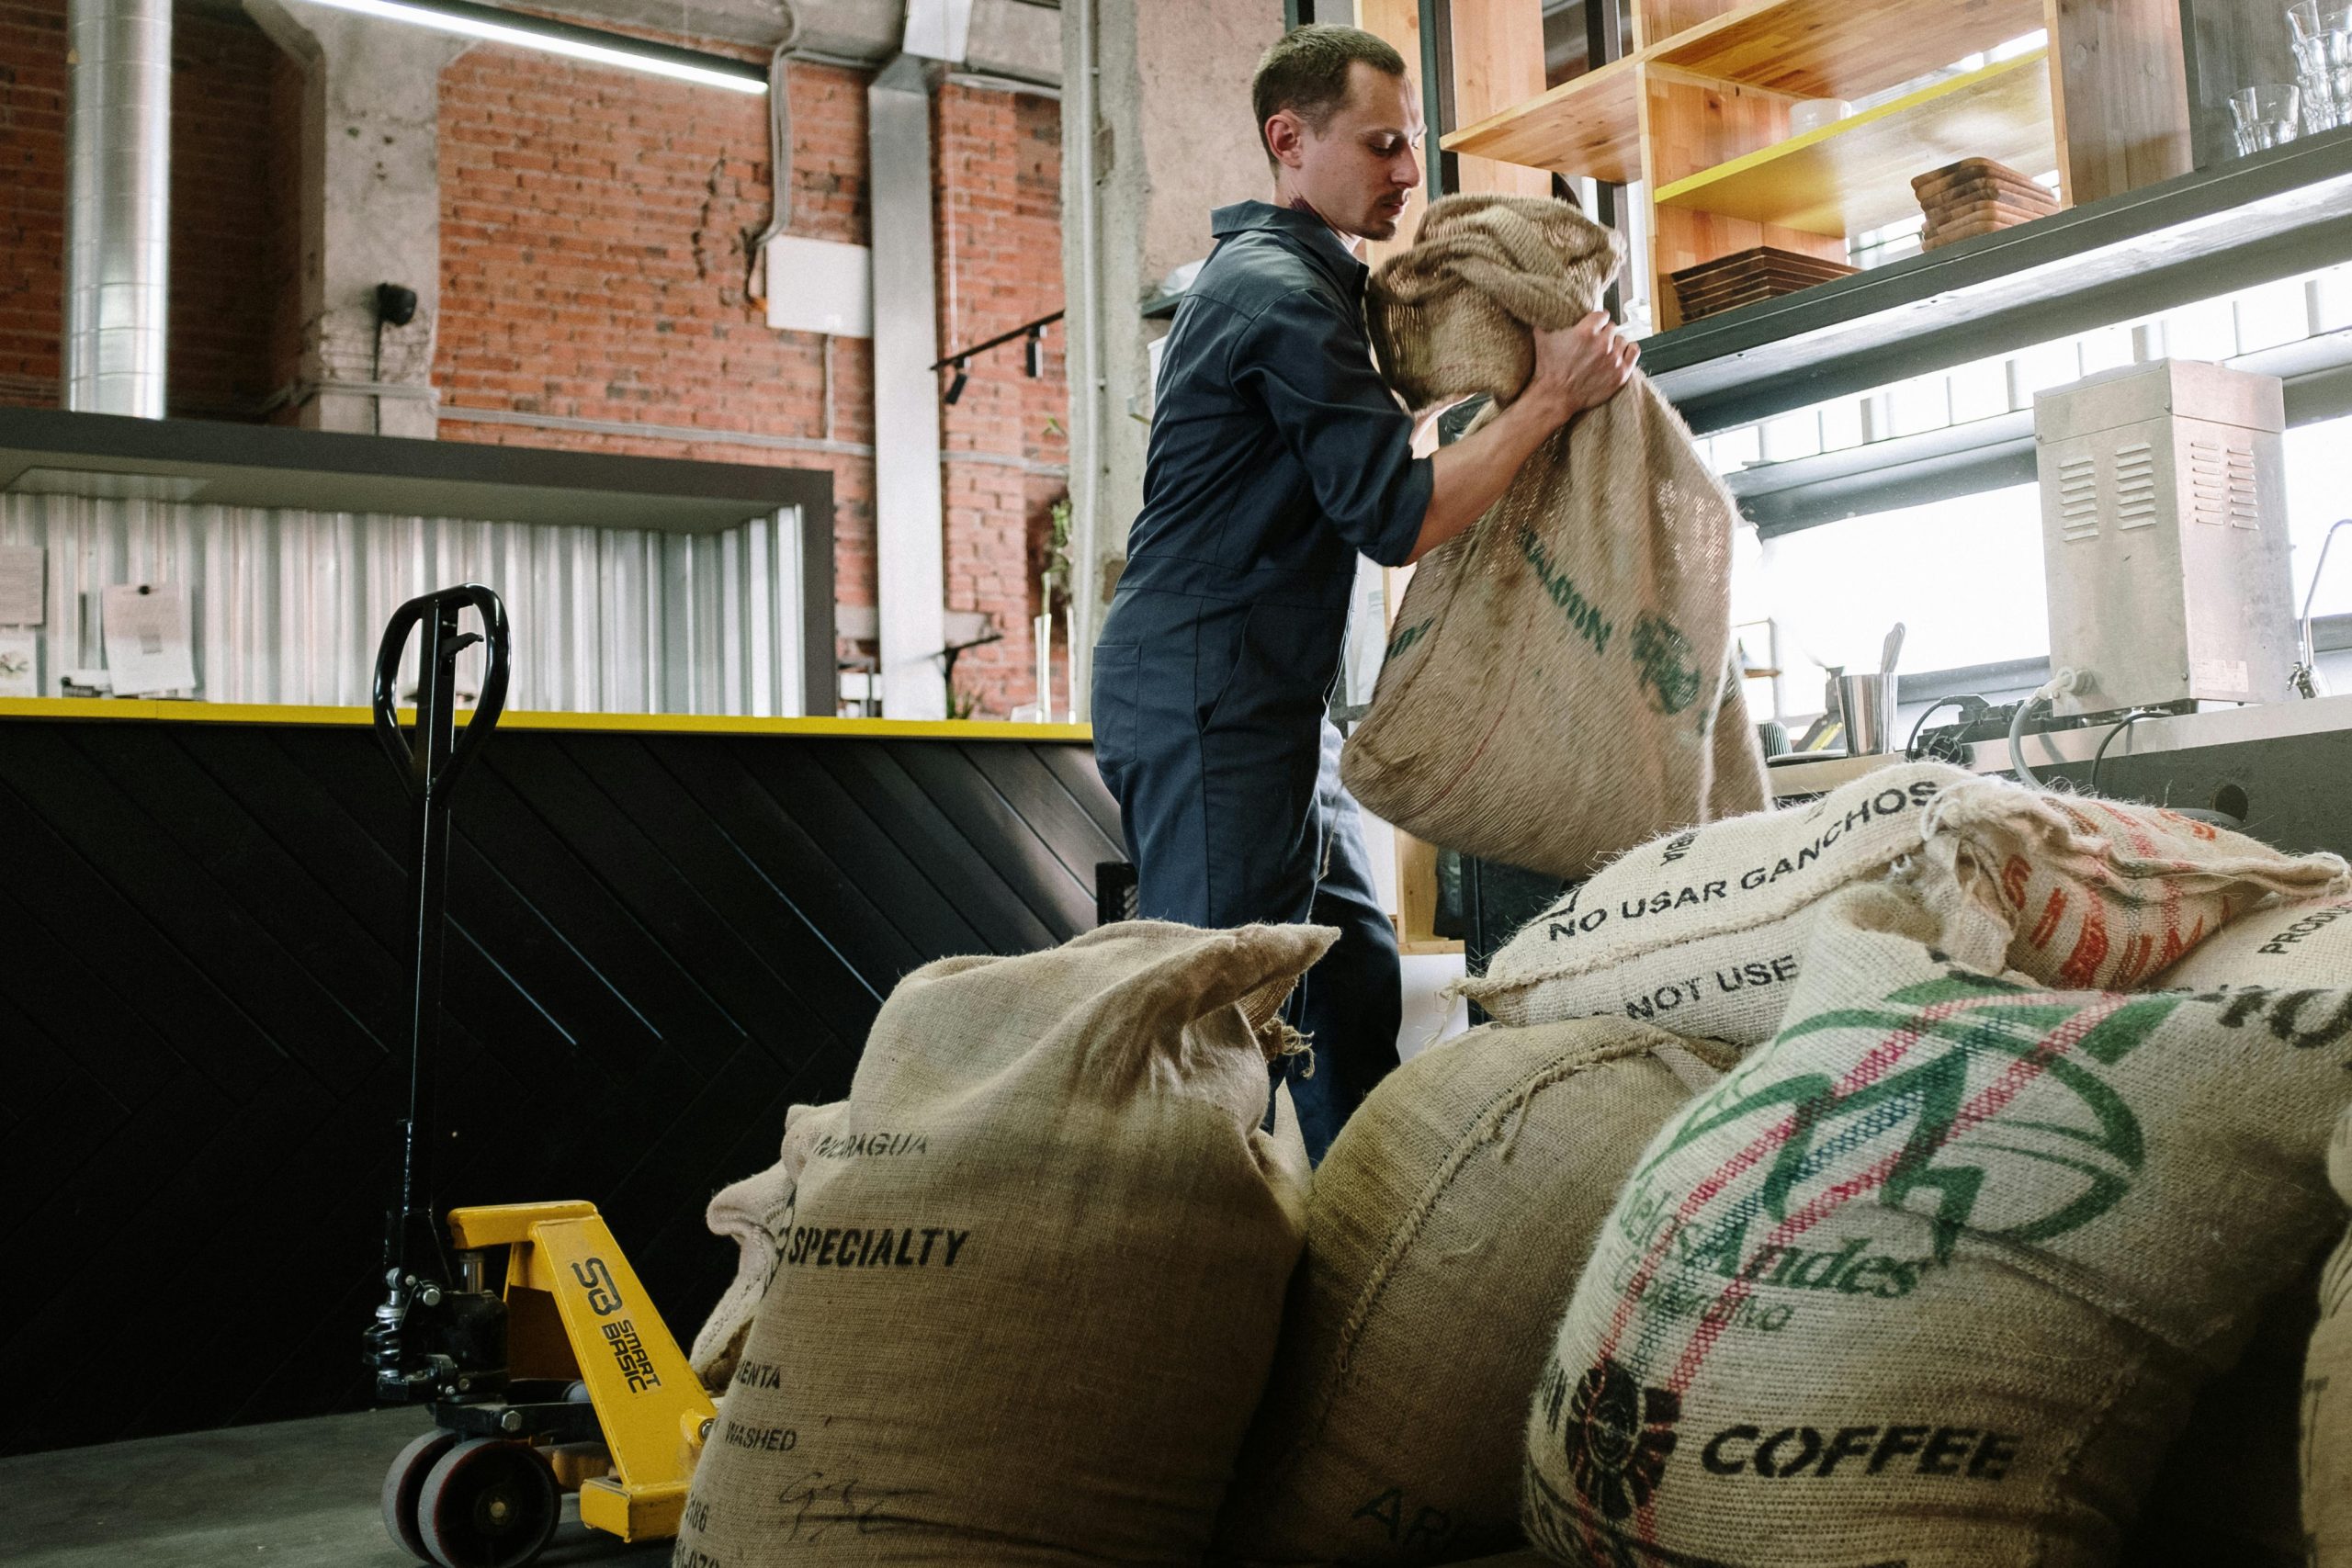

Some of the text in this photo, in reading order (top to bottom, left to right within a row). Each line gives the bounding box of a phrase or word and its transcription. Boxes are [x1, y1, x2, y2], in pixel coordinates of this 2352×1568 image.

[1549, 908, 1607, 942] NO
[1622, 880, 1727, 919] USAR
[1740, 780, 1939, 891] GANCHOS
[1625, 954, 1801, 1021] NOT USE
[787, 1225, 971, 1268] SPECIALTY
[602, 1323, 649, 1394] BASIC
[617, 1319, 662, 1387] SMART
[736, 1359, 781, 1390] ENTA
[724, 1421, 797, 1451] WASHED
[1701, 1424, 2022, 1481] COFFEE
